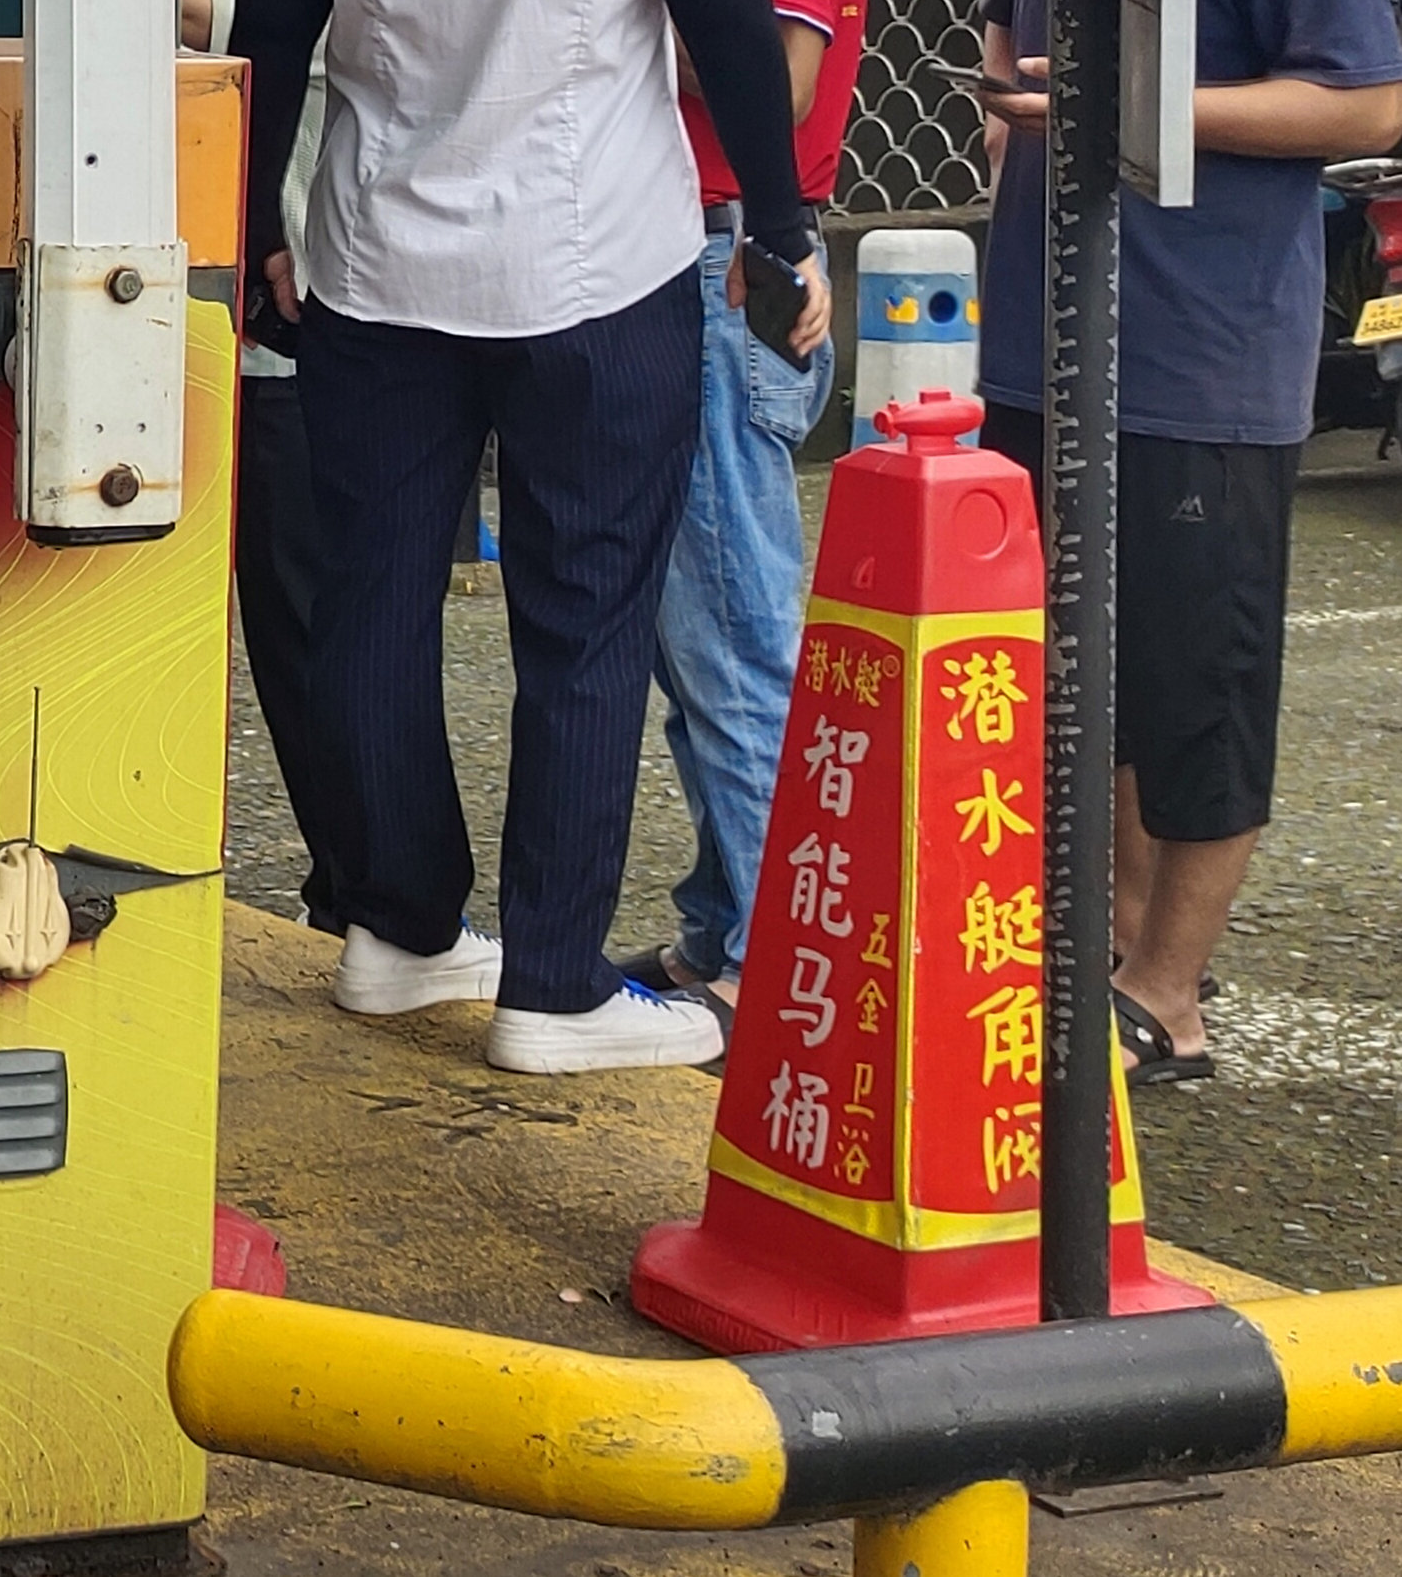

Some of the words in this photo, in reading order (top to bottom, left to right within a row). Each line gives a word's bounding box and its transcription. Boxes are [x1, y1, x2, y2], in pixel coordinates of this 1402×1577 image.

[761, 714, 871, 1170] 智能马桶
[834, 911, 893, 1186] 五金卫浴
